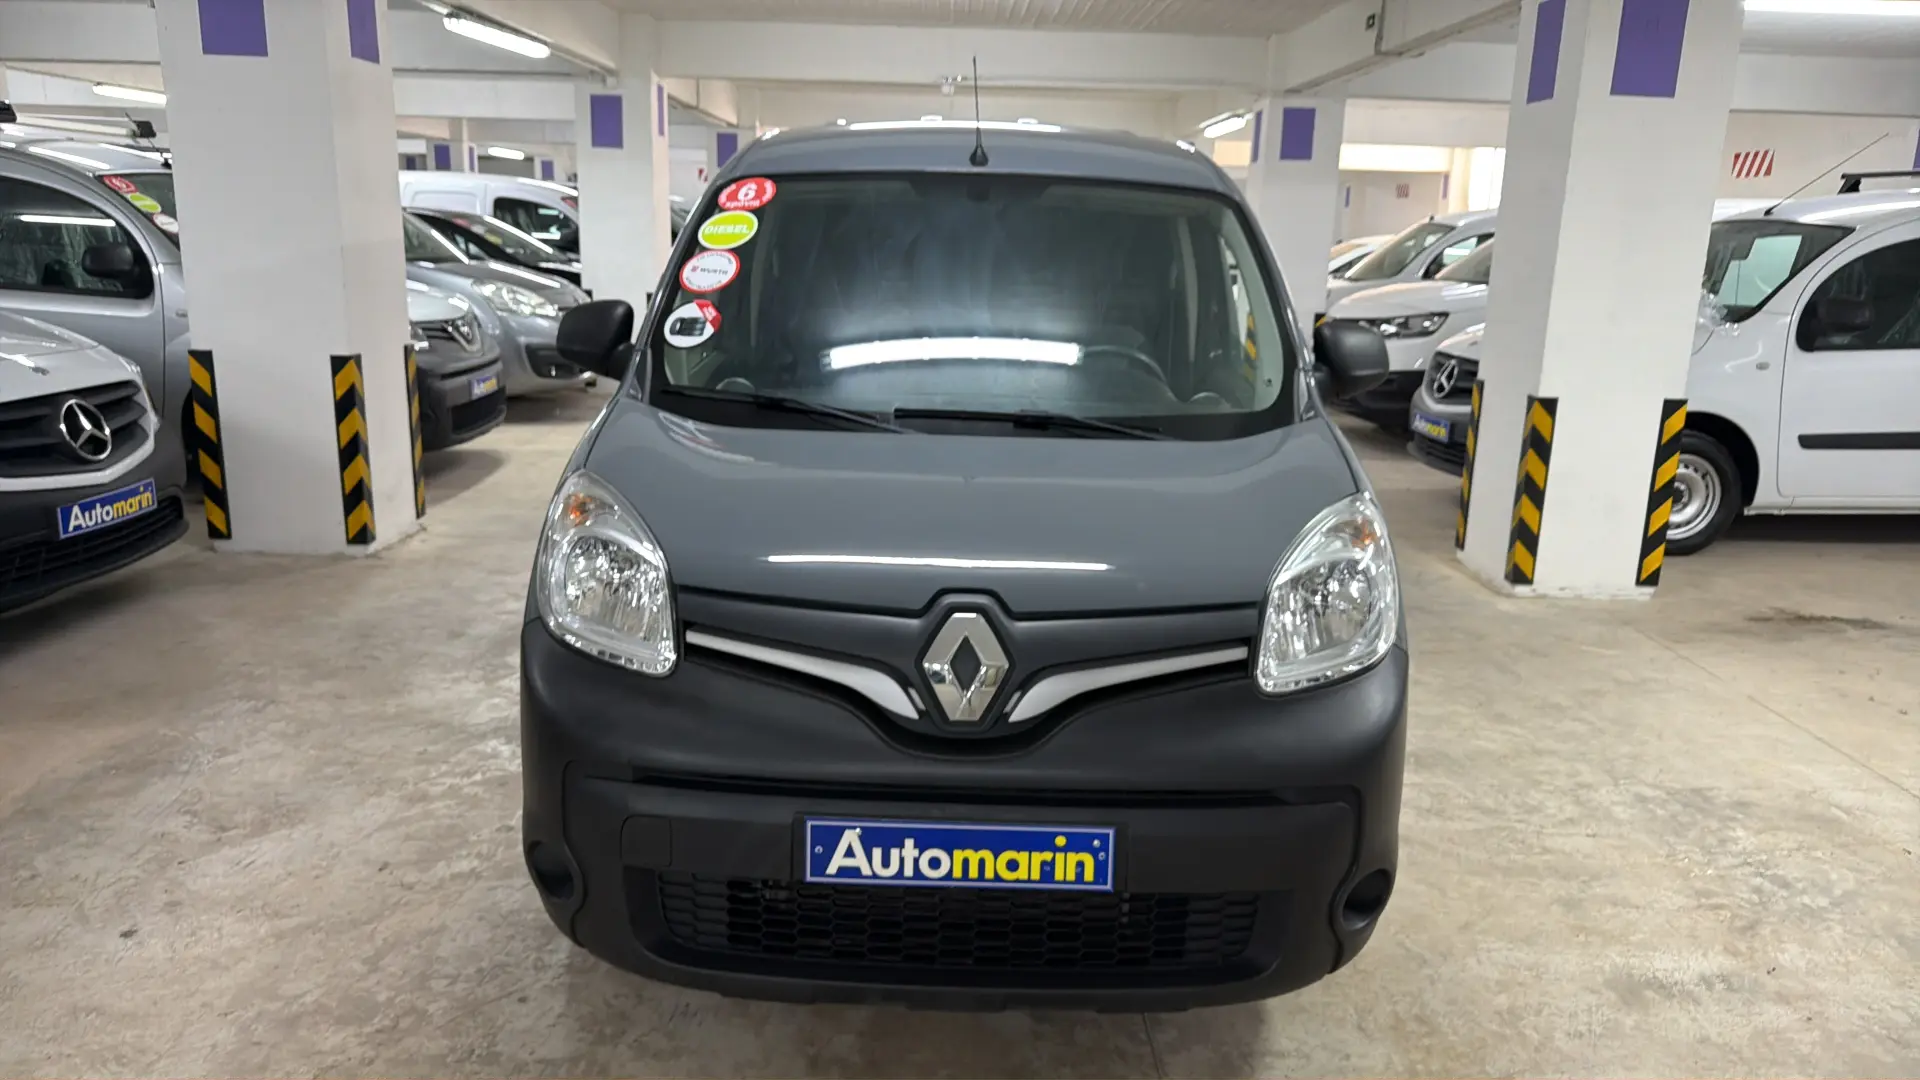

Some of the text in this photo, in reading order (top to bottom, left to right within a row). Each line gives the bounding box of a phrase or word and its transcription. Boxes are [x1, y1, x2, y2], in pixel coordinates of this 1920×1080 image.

[737, 182, 758, 201] 6
[703, 224, 750, 235] DIESEL
[68, 485, 153, 532] Automarin
[825, 828, 1094, 882] Automarin
